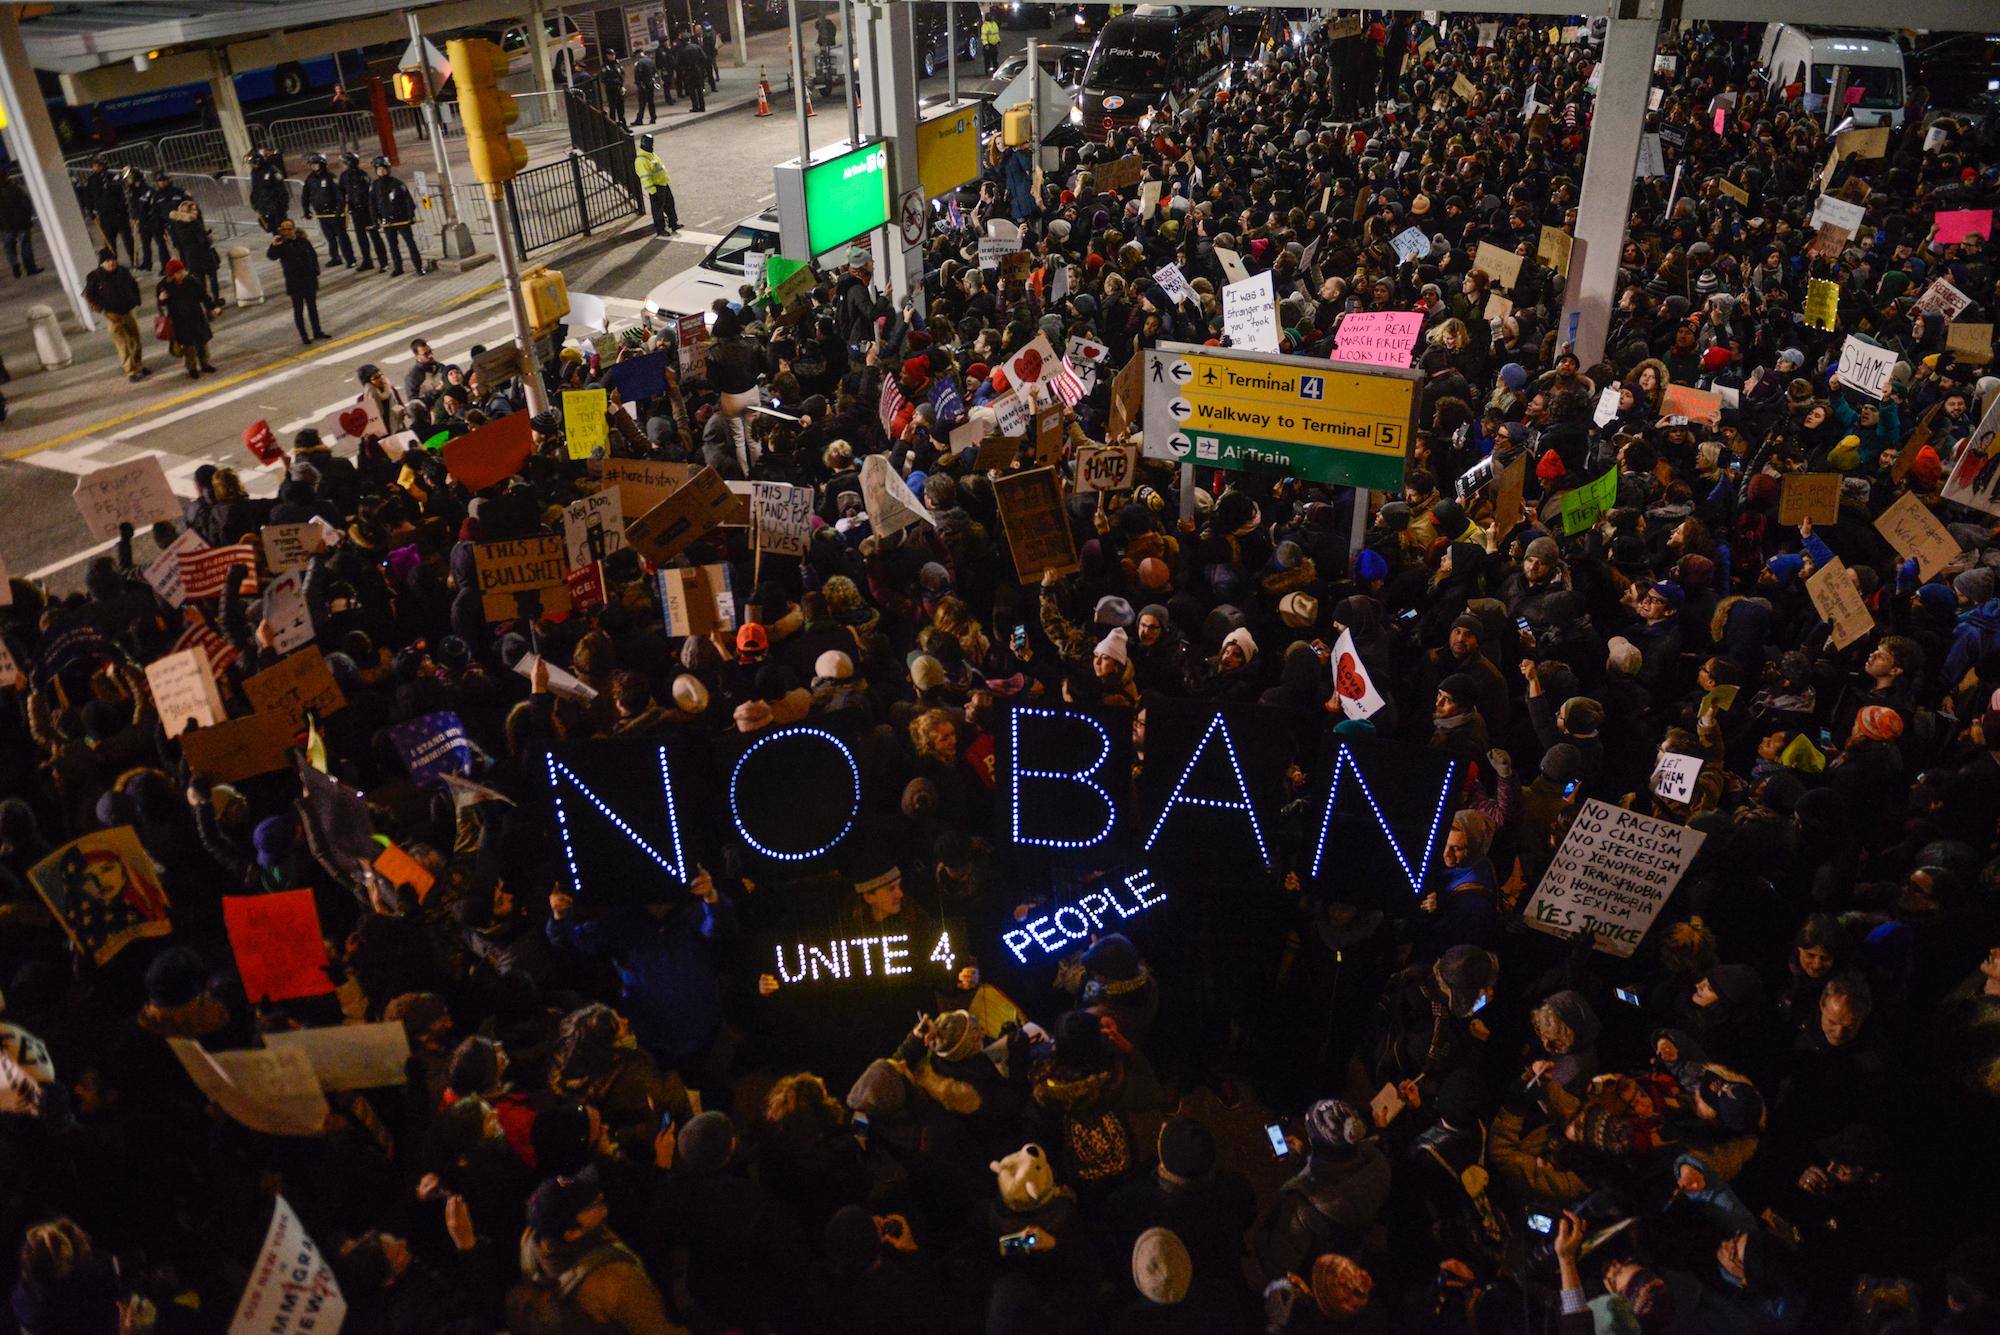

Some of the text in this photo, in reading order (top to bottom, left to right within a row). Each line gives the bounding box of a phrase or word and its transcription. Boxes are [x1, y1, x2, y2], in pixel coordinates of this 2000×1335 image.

[1138, 50, 1160, 60] JFK
[1155, 267, 1176, 281] RESIST
[1240, 290, 1257, 301] was
[1260, 288, 1266, 297] a
[1227, 305, 1260, 321] stranger
[1350, 313, 1395, 322] THIS IS
[1230, 317, 1269, 334] you took
[1343, 325, 1370, 333] WHAT
[1384, 324, 1415, 335] REAL
[1071, 342, 1083, 355] I
[1341, 336, 1373, 347] MARCH
[1392, 339, 1411, 350] LIFE
[1339, 351, 1405, 363] LOOKS LIKE
[1839, 344, 1895, 390] SHAME
[1227, 373, 1320, 399] Terminal 4
[1197, 404, 1393, 444] Walkway to Terminal 5
[1223, 445, 1290, 466] AirTrain
[1086, 456, 1127, 479] HATE
[753, 484, 813, 506] THIS JEW
[1578, 477, 1609, 505] LET
[568, 504, 586, 524] Hey
[792, 504, 810, 524] FOR
[1567, 503, 1600, 525] THEM
[485, 537, 559, 559] THIS IS
[760, 537, 800, 551] LIVES
[1893, 519, 1931, 566] Welcome
[482, 559, 563, 589] BULLSHIT
[1342, 665, 1362, 695] LOVE
[416, 733, 445, 754] STAND
[1661, 758, 1682, 769] LET
[1658, 782, 1672, 795] IN
[546, 707, 1456, 893] NO BAN
[1582, 803, 1681, 843] NO RACISM
[1577, 818, 1681, 857] NO CLASSISM
[1569, 831, 1681, 875] NO SPECIESISM
[1561, 844, 1667, 886] NO XENOPHOBIA
[1553, 857, 1663, 901] NO TRANSPHOBIA
[1540, 883, 1630, 920] NO SEXISM
[1546, 871, 1652, 914] NO HOMOPHOBIA
[1002, 869, 1168, 963] PEOPLE
[1536, 900, 1643, 944] YES JUSTICE
[776, 933, 955, 982] UNITE 4
